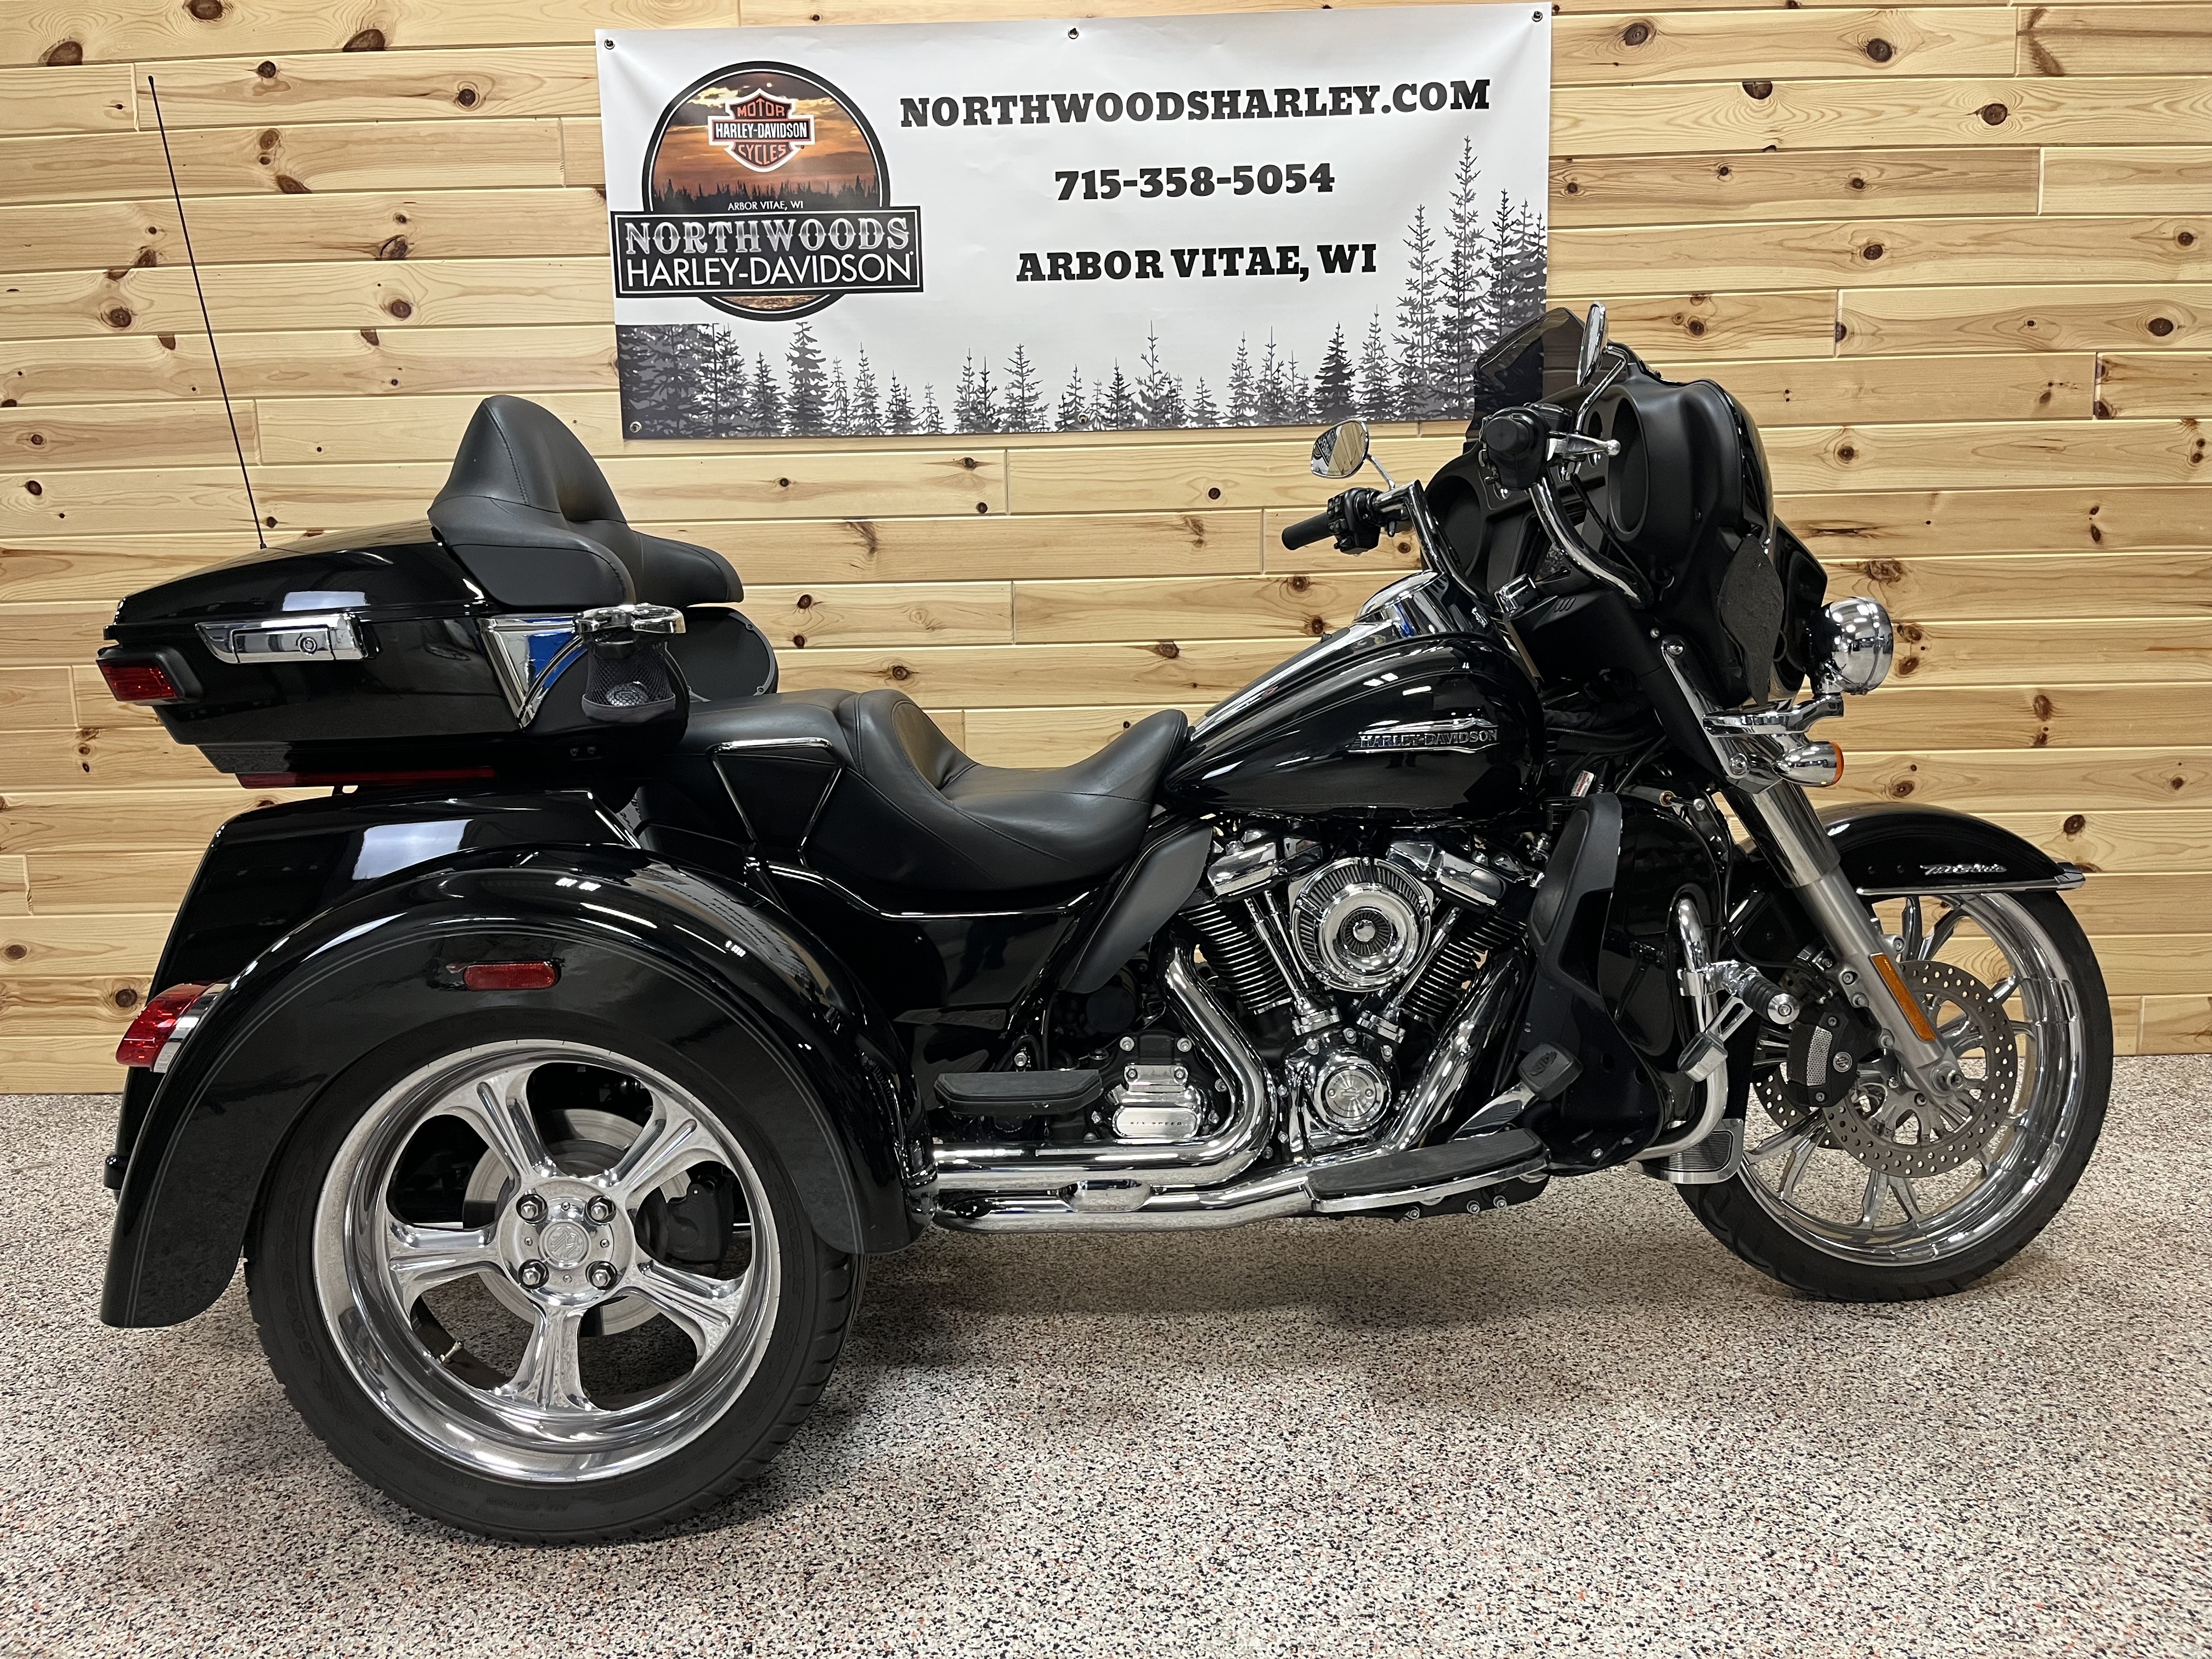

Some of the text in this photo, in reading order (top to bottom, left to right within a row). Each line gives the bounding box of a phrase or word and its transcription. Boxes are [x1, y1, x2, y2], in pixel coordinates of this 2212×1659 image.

[737, 98, 785, 117] MOTOR
[900, 80, 1490, 127] NORTHWOODSHARLEY.COM
[715, 122, 808, 138] HARLEY-DAVIDSON
[738, 144, 786, 165] CYCLES
[1056, 163, 1335, 200] 715-358-5054
[727, 200, 803, 211] ARBOR VITAE, WI
[625, 217, 909, 255] NORTHWOODS
[627, 252, 912, 287] HARLEY-DAVIDSON
[1017, 244, 1376, 282] ARBOR VITAE, WI
[1359, 729, 1498, 748] HARLEY-DAVIDSON
